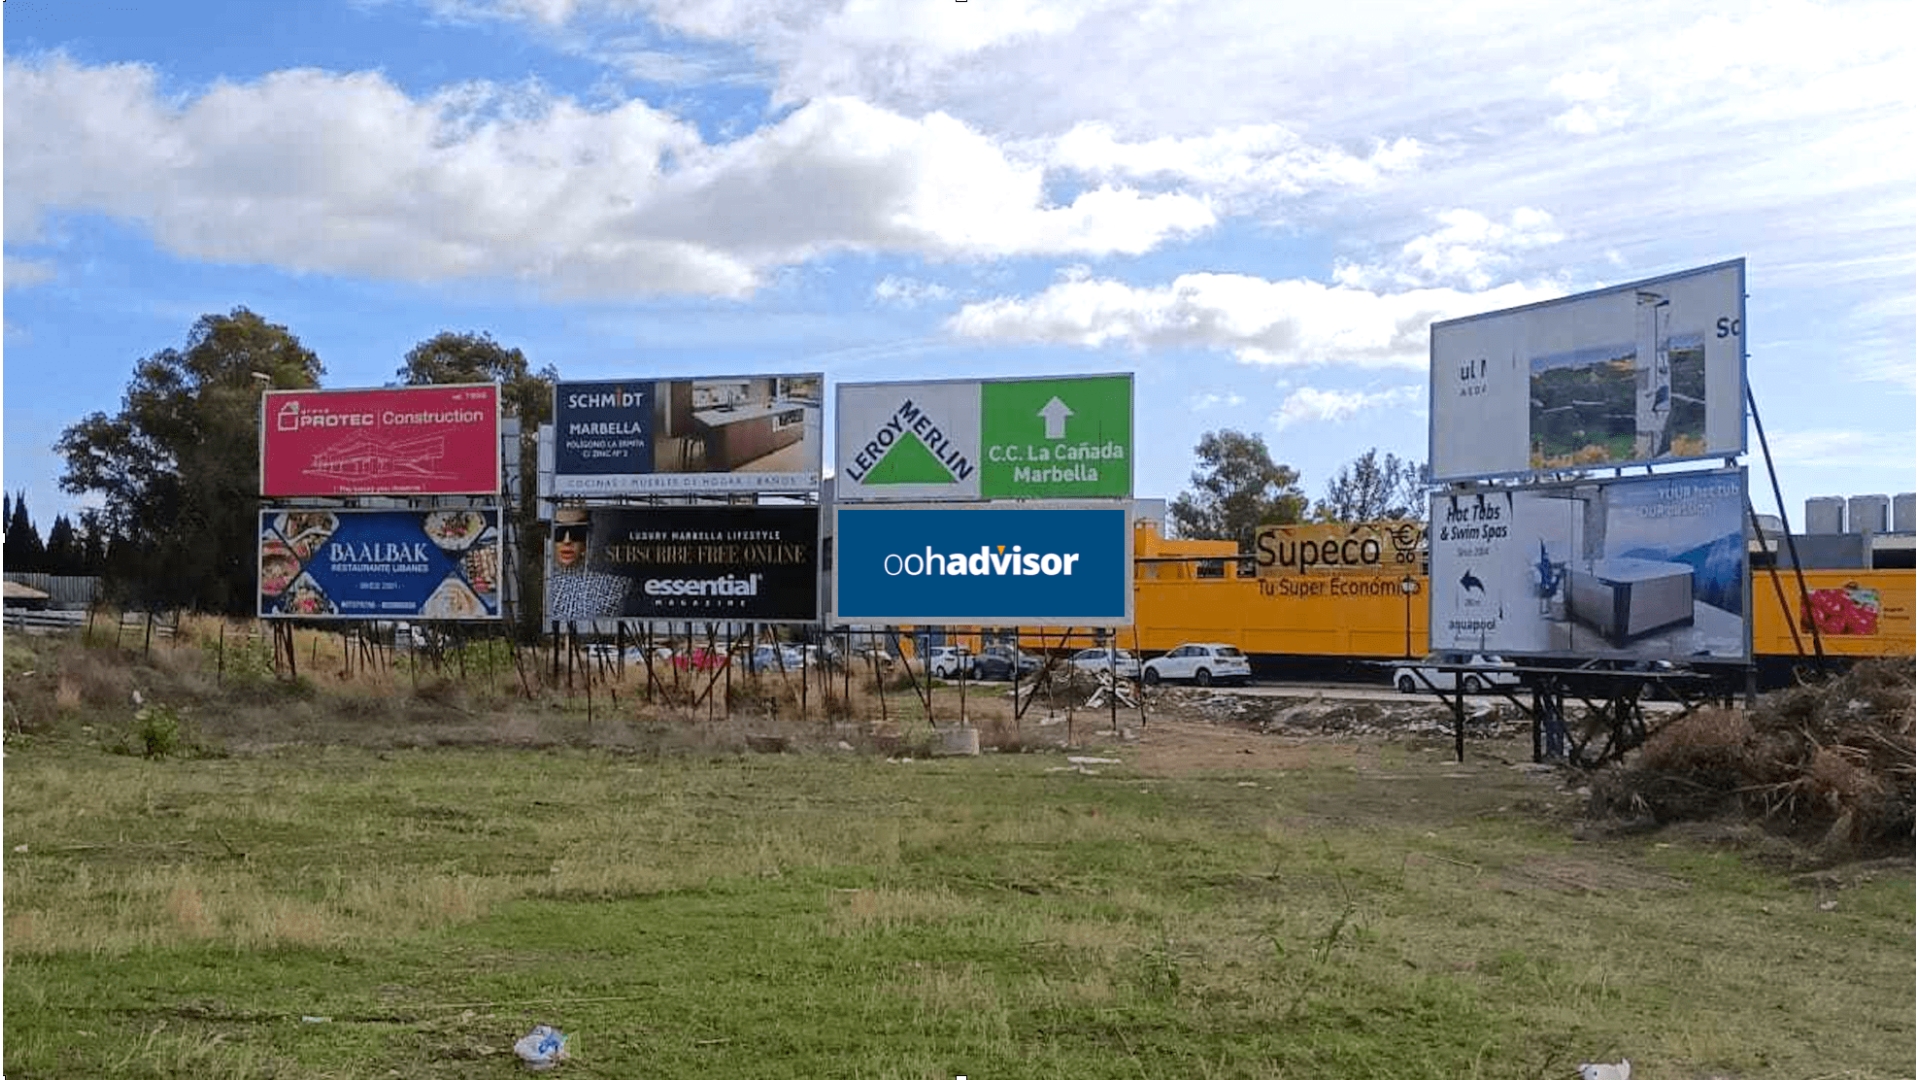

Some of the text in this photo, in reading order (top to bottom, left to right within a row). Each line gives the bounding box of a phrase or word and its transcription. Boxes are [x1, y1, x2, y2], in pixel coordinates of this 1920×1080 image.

[568, 386, 644, 408] SCHMIDT
[300, 408, 484, 427] PROTEC Construction
[569, 421, 642, 435] MARBELLA
[846, 413, 903, 482] LEROY
[898, 399, 974, 481] MERLIN
[989, 441, 1125, 462] C.C. La Cañada
[1014, 464, 1099, 483] Marbella
[628, 531, 780, 540] LUXURY MARBELLA LIFESTYLE
[1451, 526, 1480, 540] Swim
[1482, 523, 1508, 543] Spas
[329, 541, 429, 562] BAALBAK
[605, 543, 806, 564] SUBSCRIBE FREE ONLINE
[331, 563, 391, 573] RESTAURANTE
[644, 573, 758, 596] essential
[1258, 578, 1275, 596] Tu
[1279, 578, 1324, 598] Super
[655, 600, 747, 608] MAGAZINE
[1449, 618, 1496, 634] aquapool
